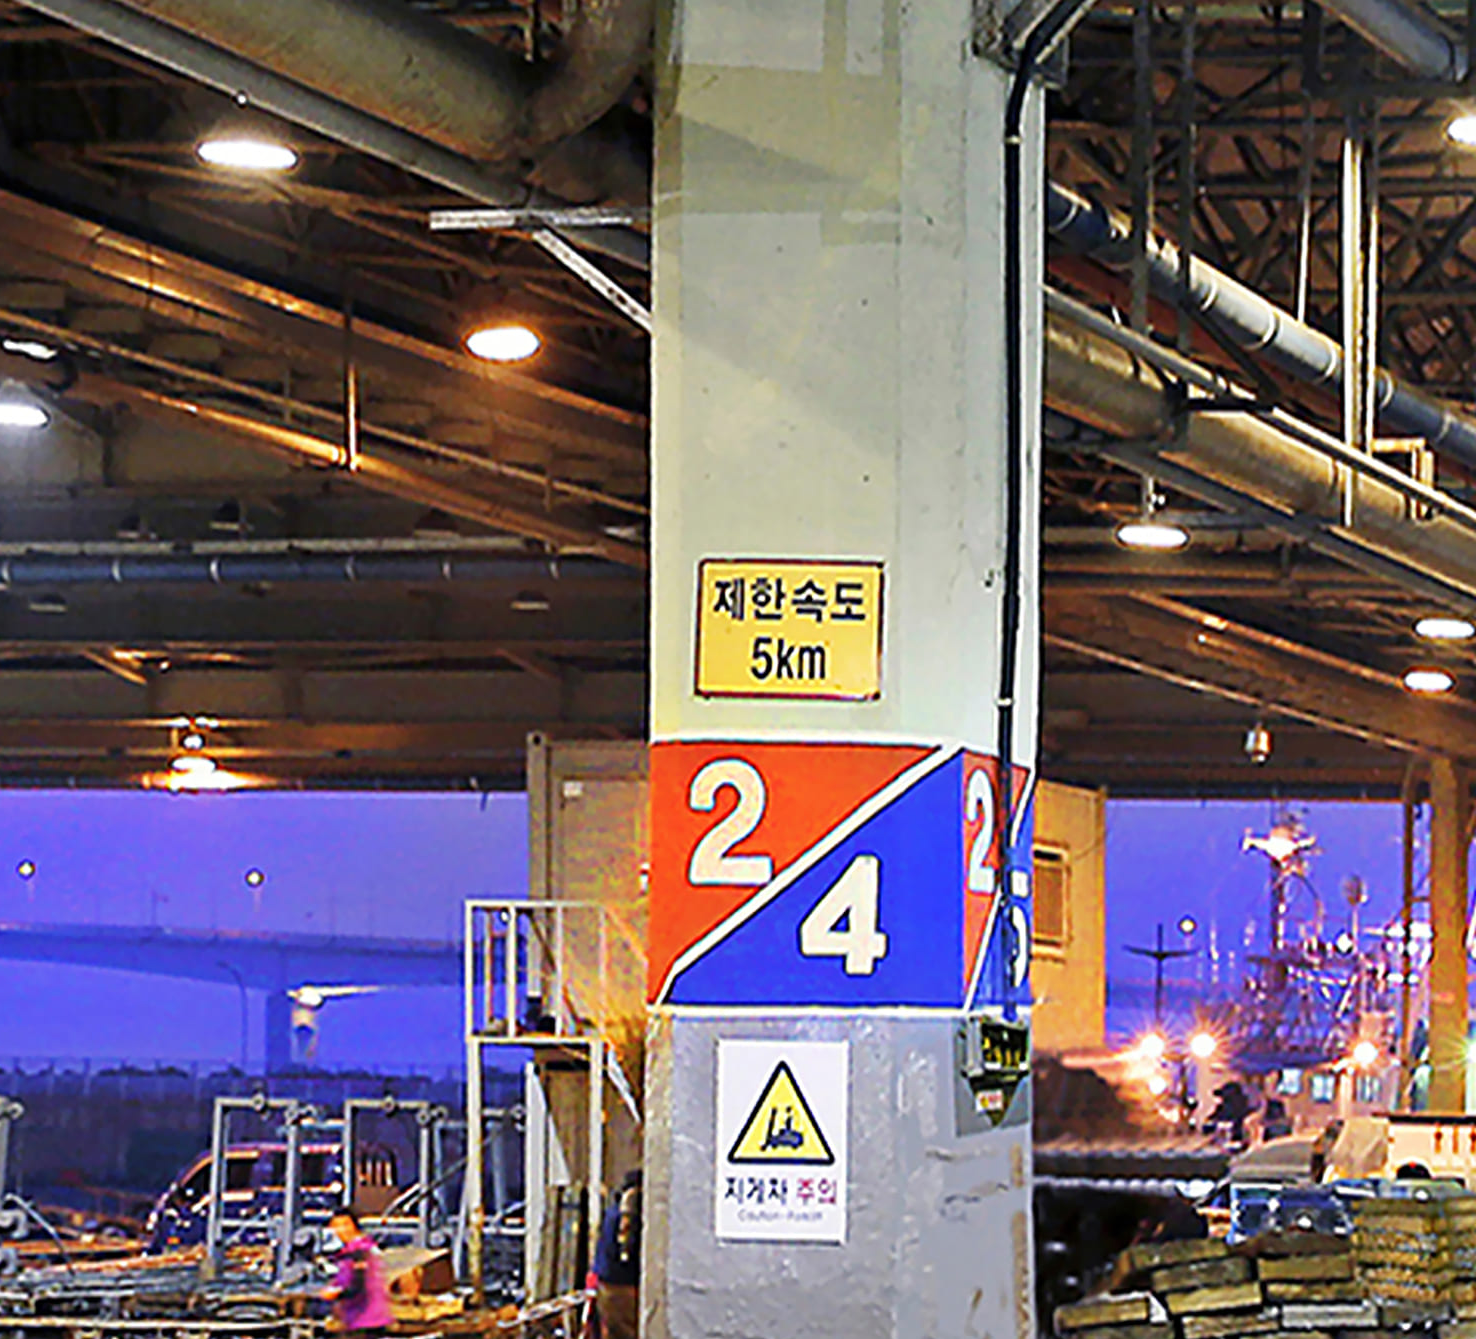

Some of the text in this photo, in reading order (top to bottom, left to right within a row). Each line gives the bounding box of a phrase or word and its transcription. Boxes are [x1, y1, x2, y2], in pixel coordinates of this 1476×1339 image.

[713, 577, 866, 623] 제한속도
[750, 636, 826, 681] 5km
[689, 757, 773, 886] 2
[963, 768, 996, 894] 2
[799, 853, 889, 976] 4
